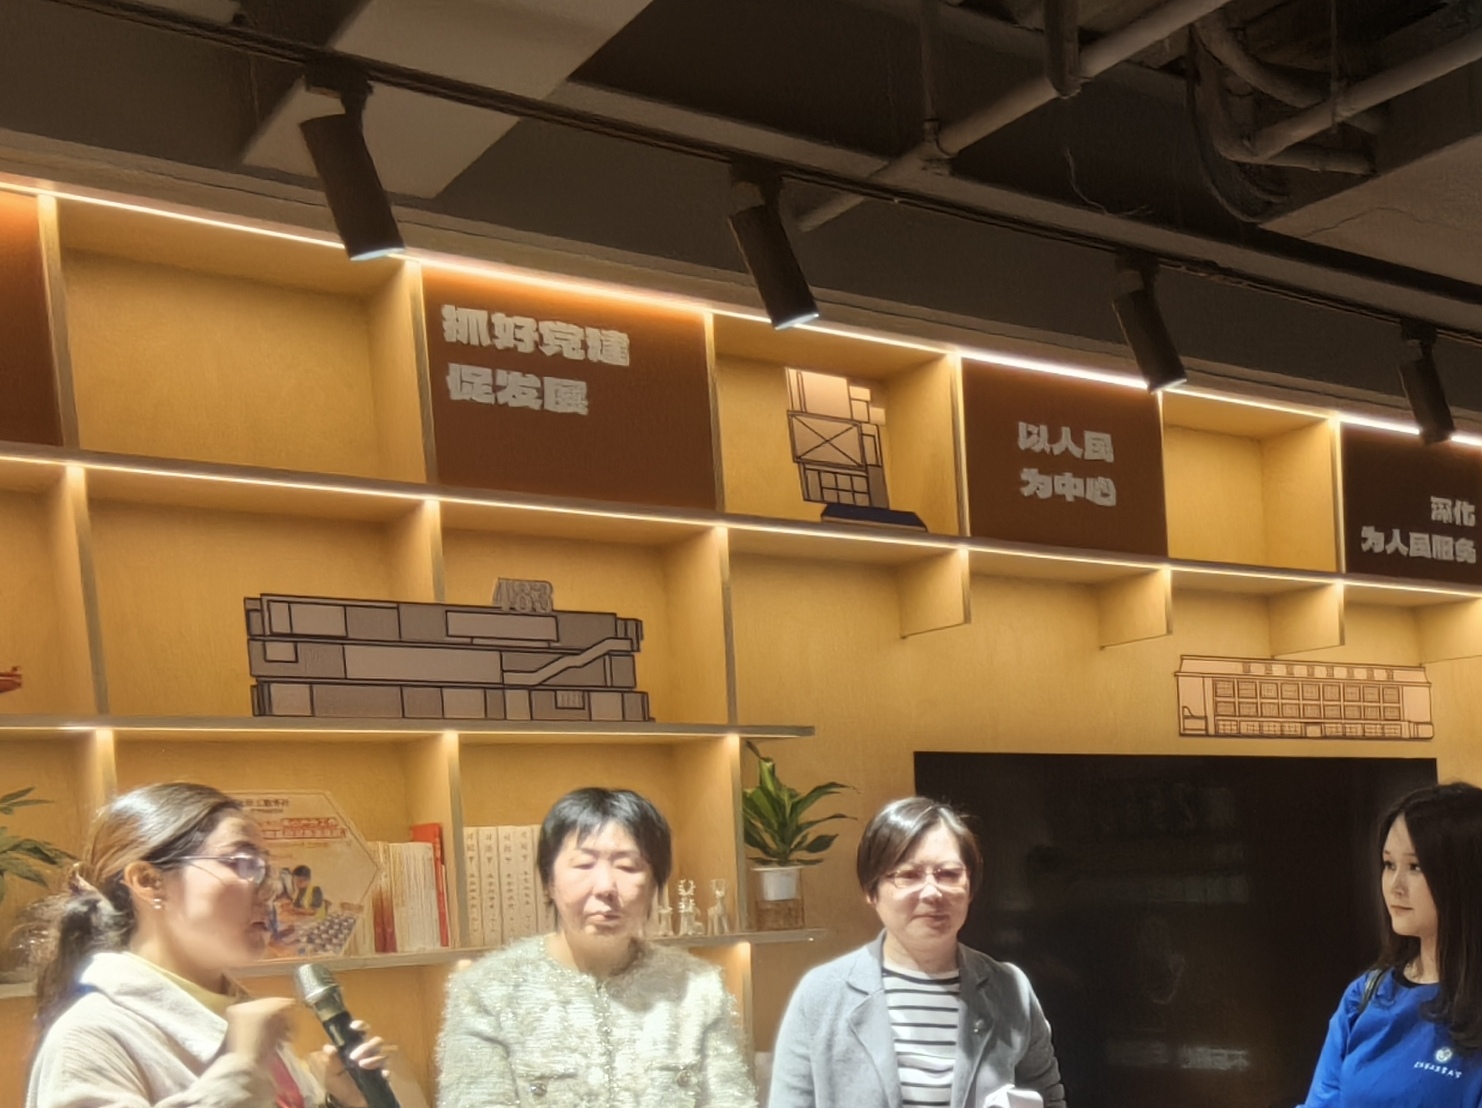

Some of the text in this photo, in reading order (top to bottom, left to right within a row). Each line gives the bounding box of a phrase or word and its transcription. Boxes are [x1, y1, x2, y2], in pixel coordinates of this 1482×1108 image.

[442, 304, 630, 367] 抓好党建
[446, 362, 589, 416] 促发展
[1017, 421, 1115, 463] 以人民
[1019, 468, 1117, 507] 为中心
[1430, 496, 1476, 527] 深化
[1361, 525, 1477, 564] 为人民服务
